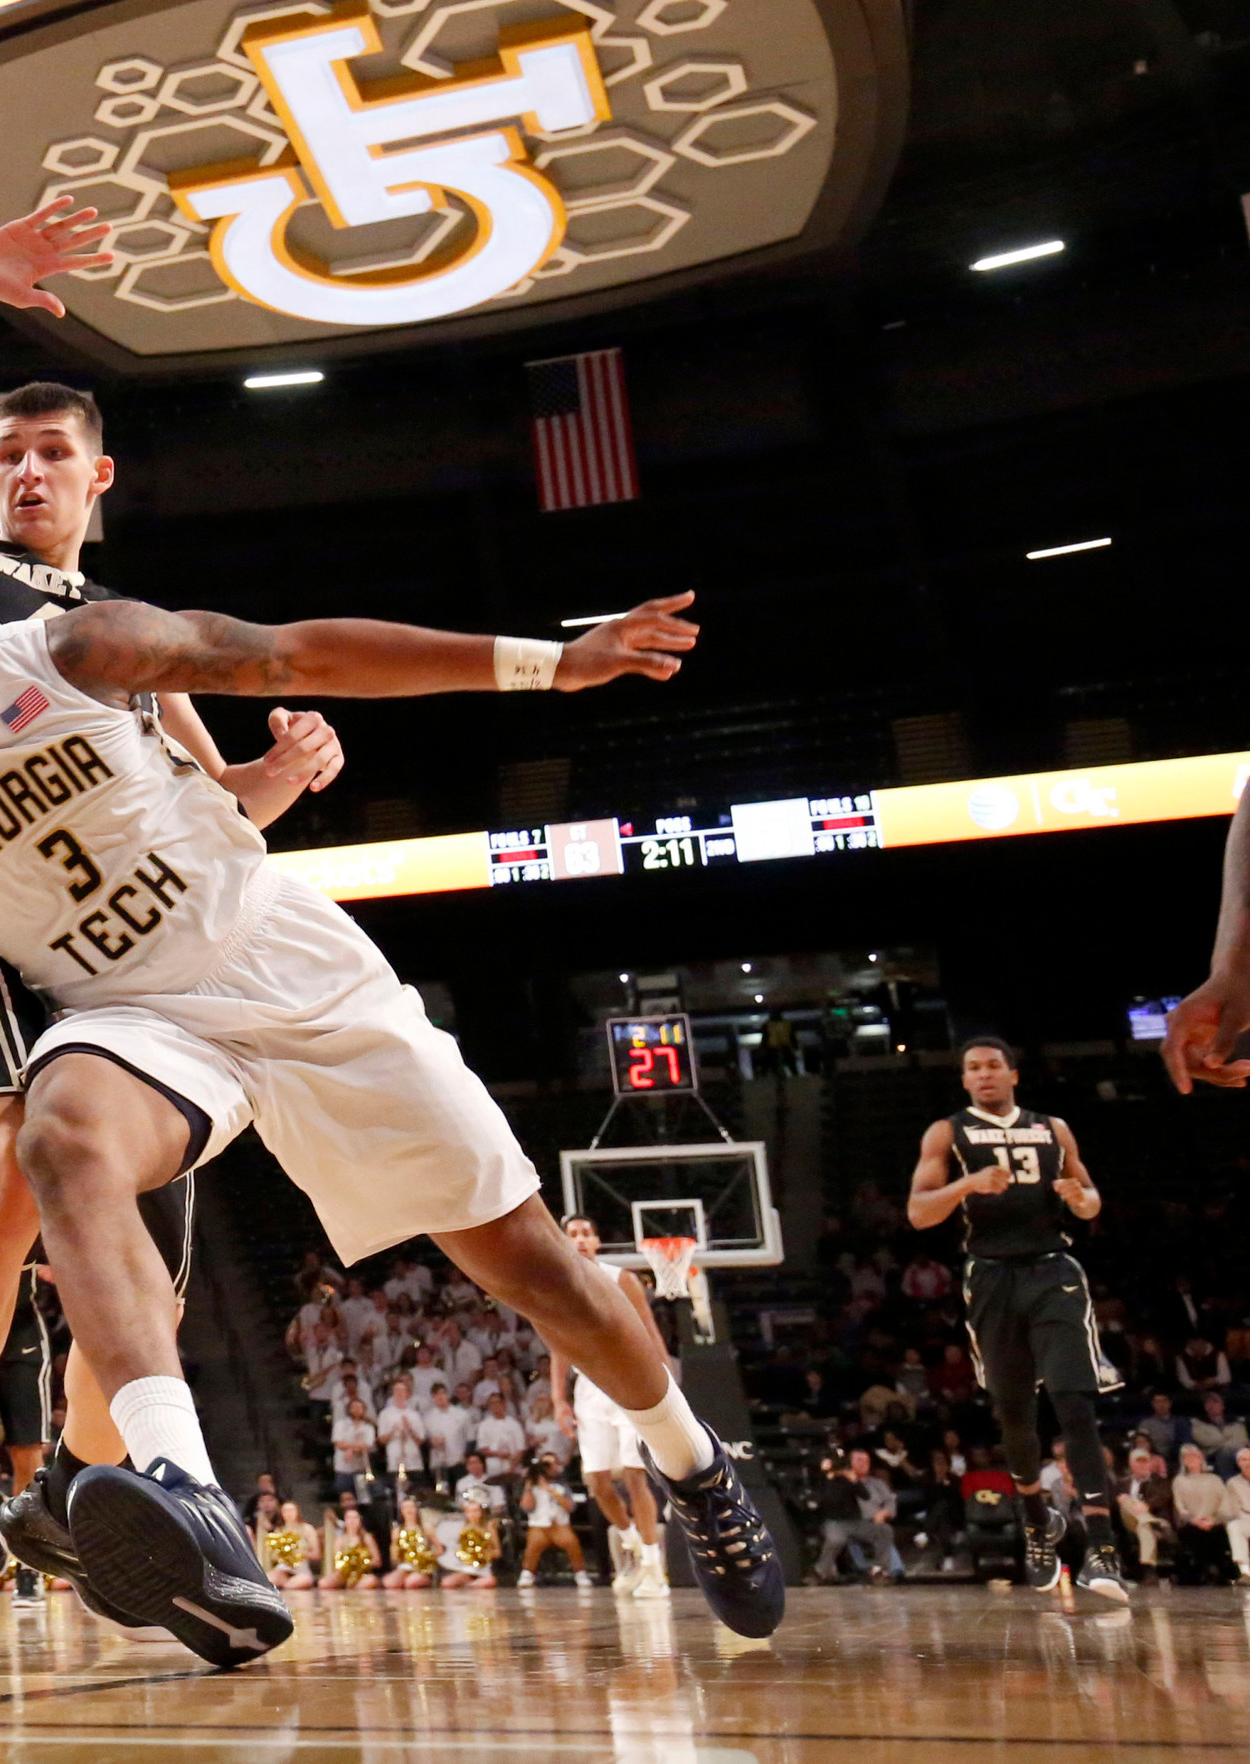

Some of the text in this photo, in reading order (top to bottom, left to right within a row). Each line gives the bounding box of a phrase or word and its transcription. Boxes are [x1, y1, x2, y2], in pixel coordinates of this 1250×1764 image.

[36, 828, 103, 903] 3
[641, 837, 695, 870] 2:11
[48, 852, 188, 976] TECH
[628, 1046, 682, 1089] 27
[992, 1146, 1041, 1185] 13
